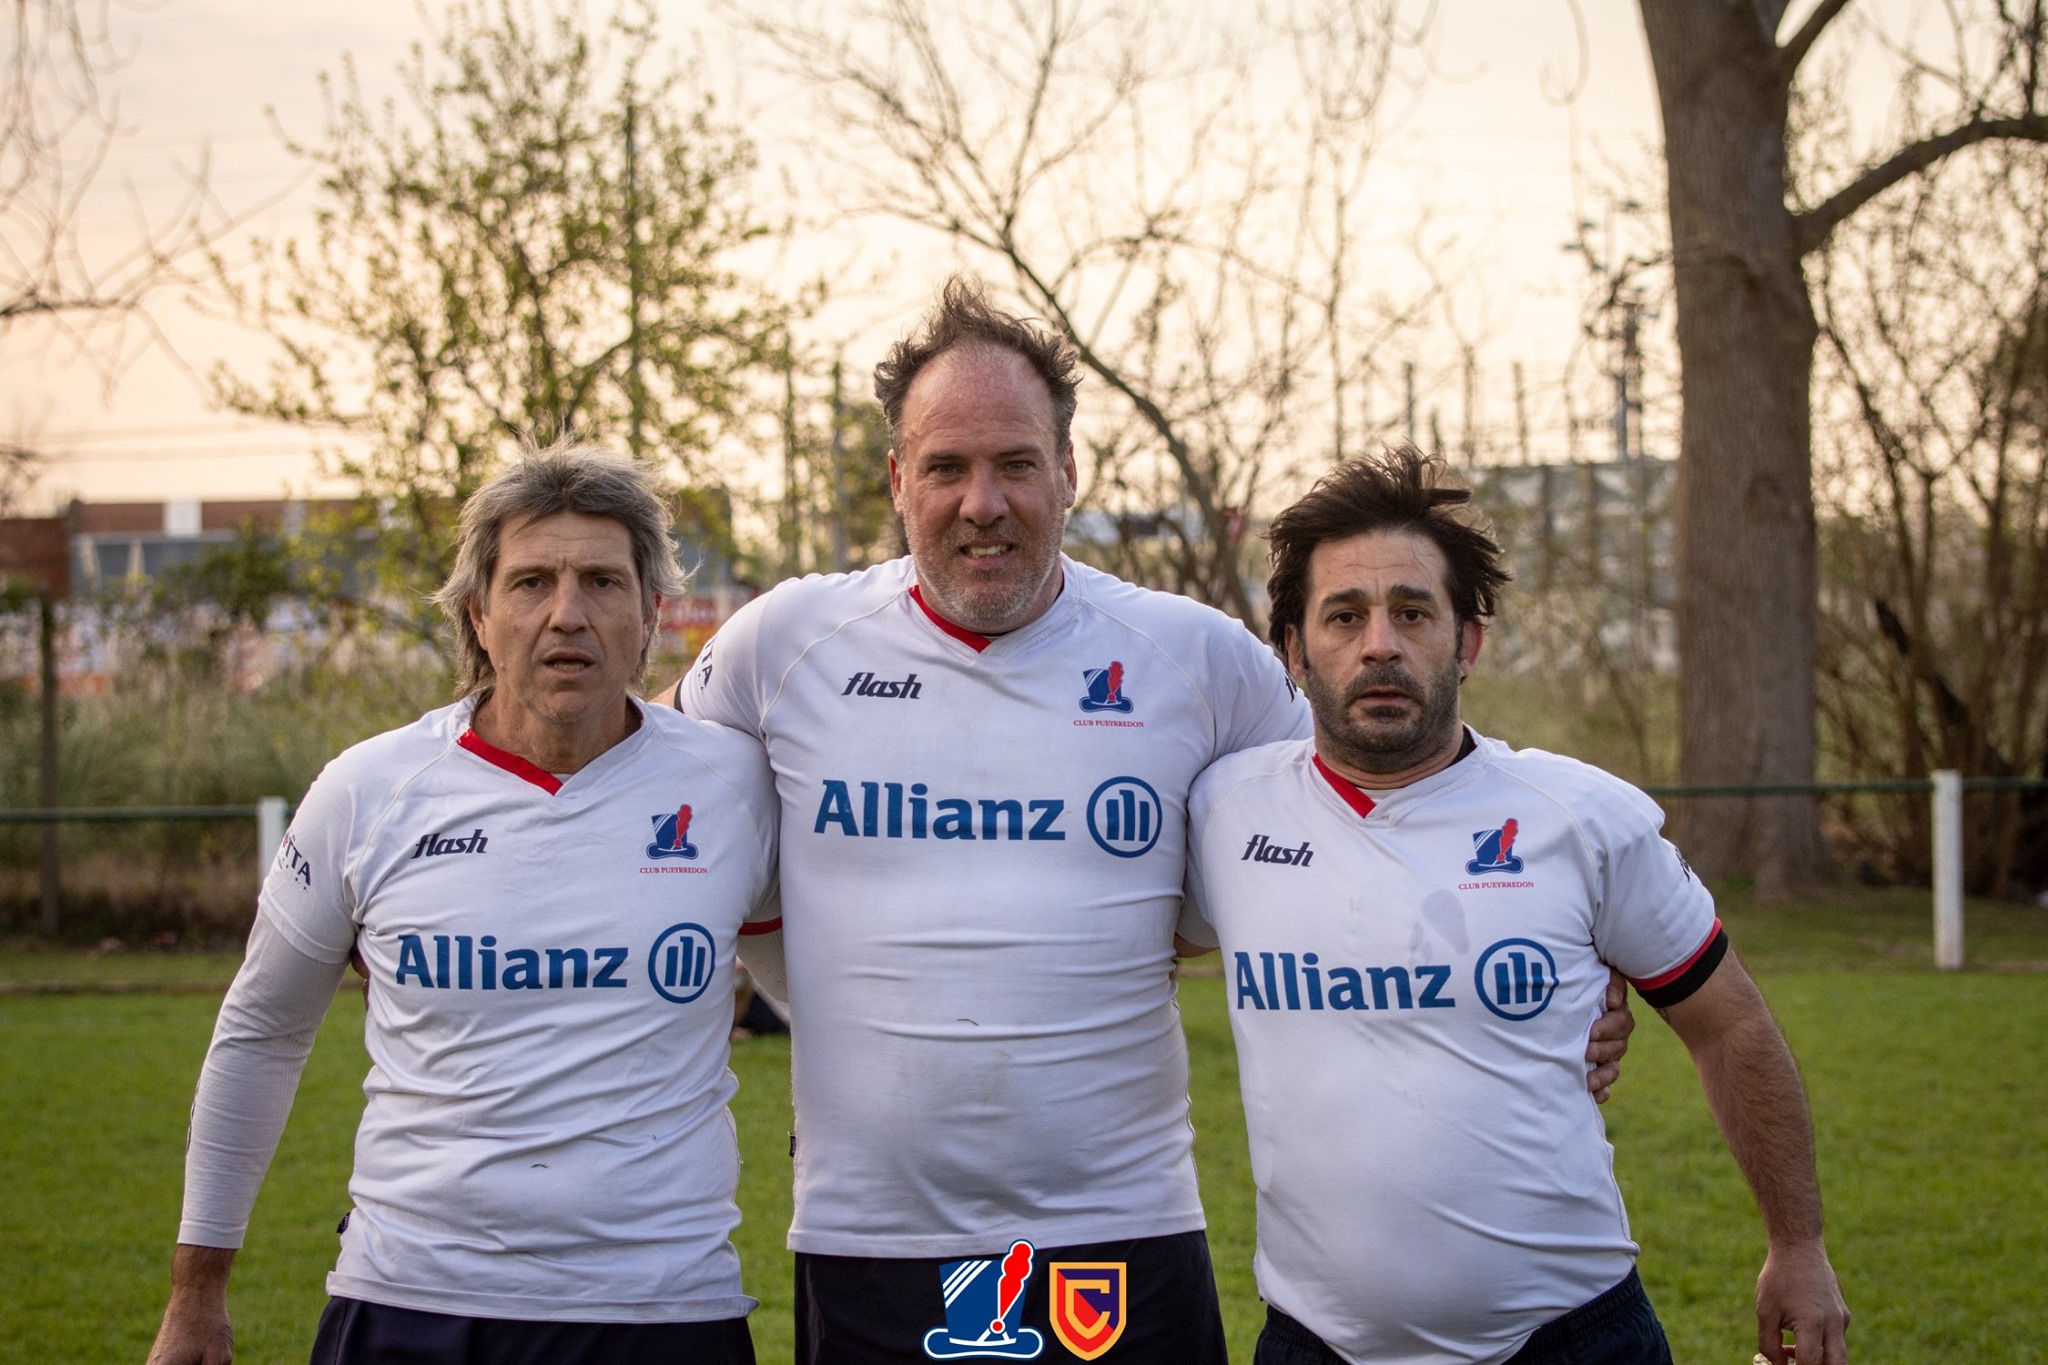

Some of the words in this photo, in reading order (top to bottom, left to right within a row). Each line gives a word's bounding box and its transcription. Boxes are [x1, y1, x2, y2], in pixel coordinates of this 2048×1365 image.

[841, 672, 923, 700] flash
[1095, 720, 1144, 728] PUEYRREDON
[814, 779, 1066, 841] Allianz
[409, 828, 489, 860] flash
[1240, 833, 1315, 868] flash
[661, 866, 708, 874] PUEYRREDON
[1481, 881, 1534, 889] PUEYRREDON
[395, 933, 629, 991] Allianz
[1234, 950, 1456, 1011] Allianz
